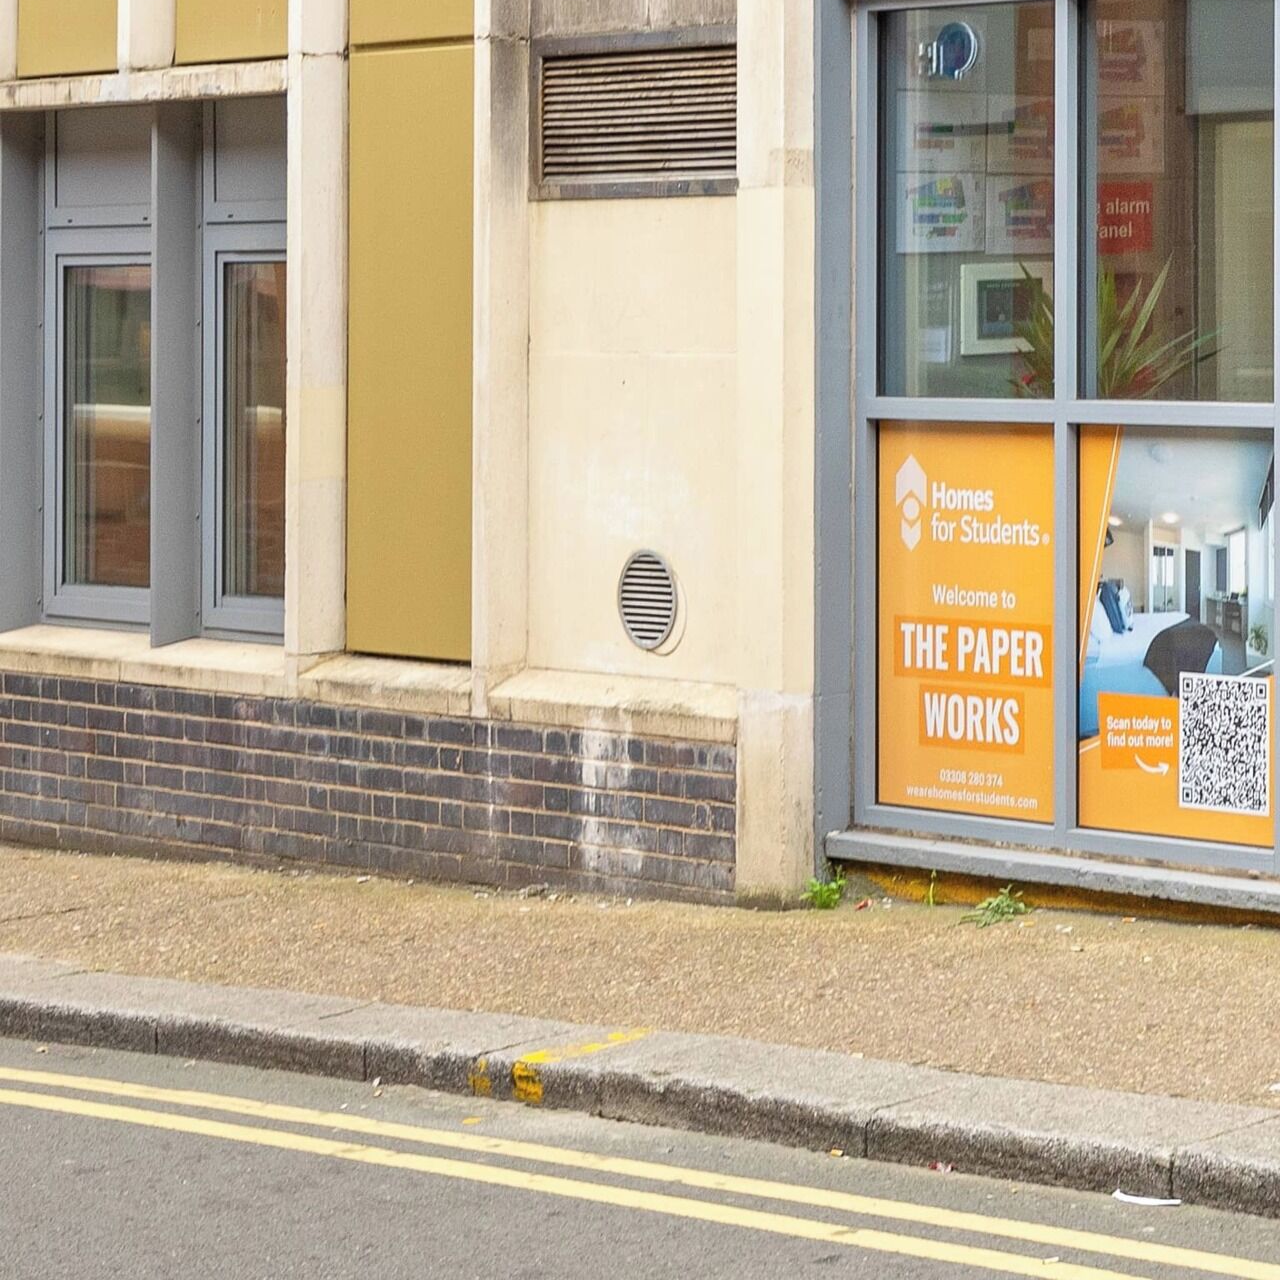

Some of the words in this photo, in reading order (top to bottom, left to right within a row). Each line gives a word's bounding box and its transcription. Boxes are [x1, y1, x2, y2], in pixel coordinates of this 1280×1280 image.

[1106, 197, 1150, 215] alarm
[1096, 220, 1133, 239] anel
[931, 483, 994, 511] Homes
[931, 514, 956, 542] for
[931, 583, 998, 609] Welcome
[1001, 590, 1016, 610] to
[900, 622, 948, 670] THE
[957, 626, 1044, 678] PAPER
[924, 691, 1020, 745] WORKS
[1106, 714, 1131, 731] Scan
[1132, 714, 1160, 734] today
[1161, 715, 1172, 731] to
[1107, 731, 1126, 748] find
[1128, 733, 1144, 748] out
[1146, 732, 1174, 748] more!
[968, 770, 984, 786] 280
[986, 772, 1003, 788] 374
[906, 784, 1038, 809] wearehomesforstudents.com
